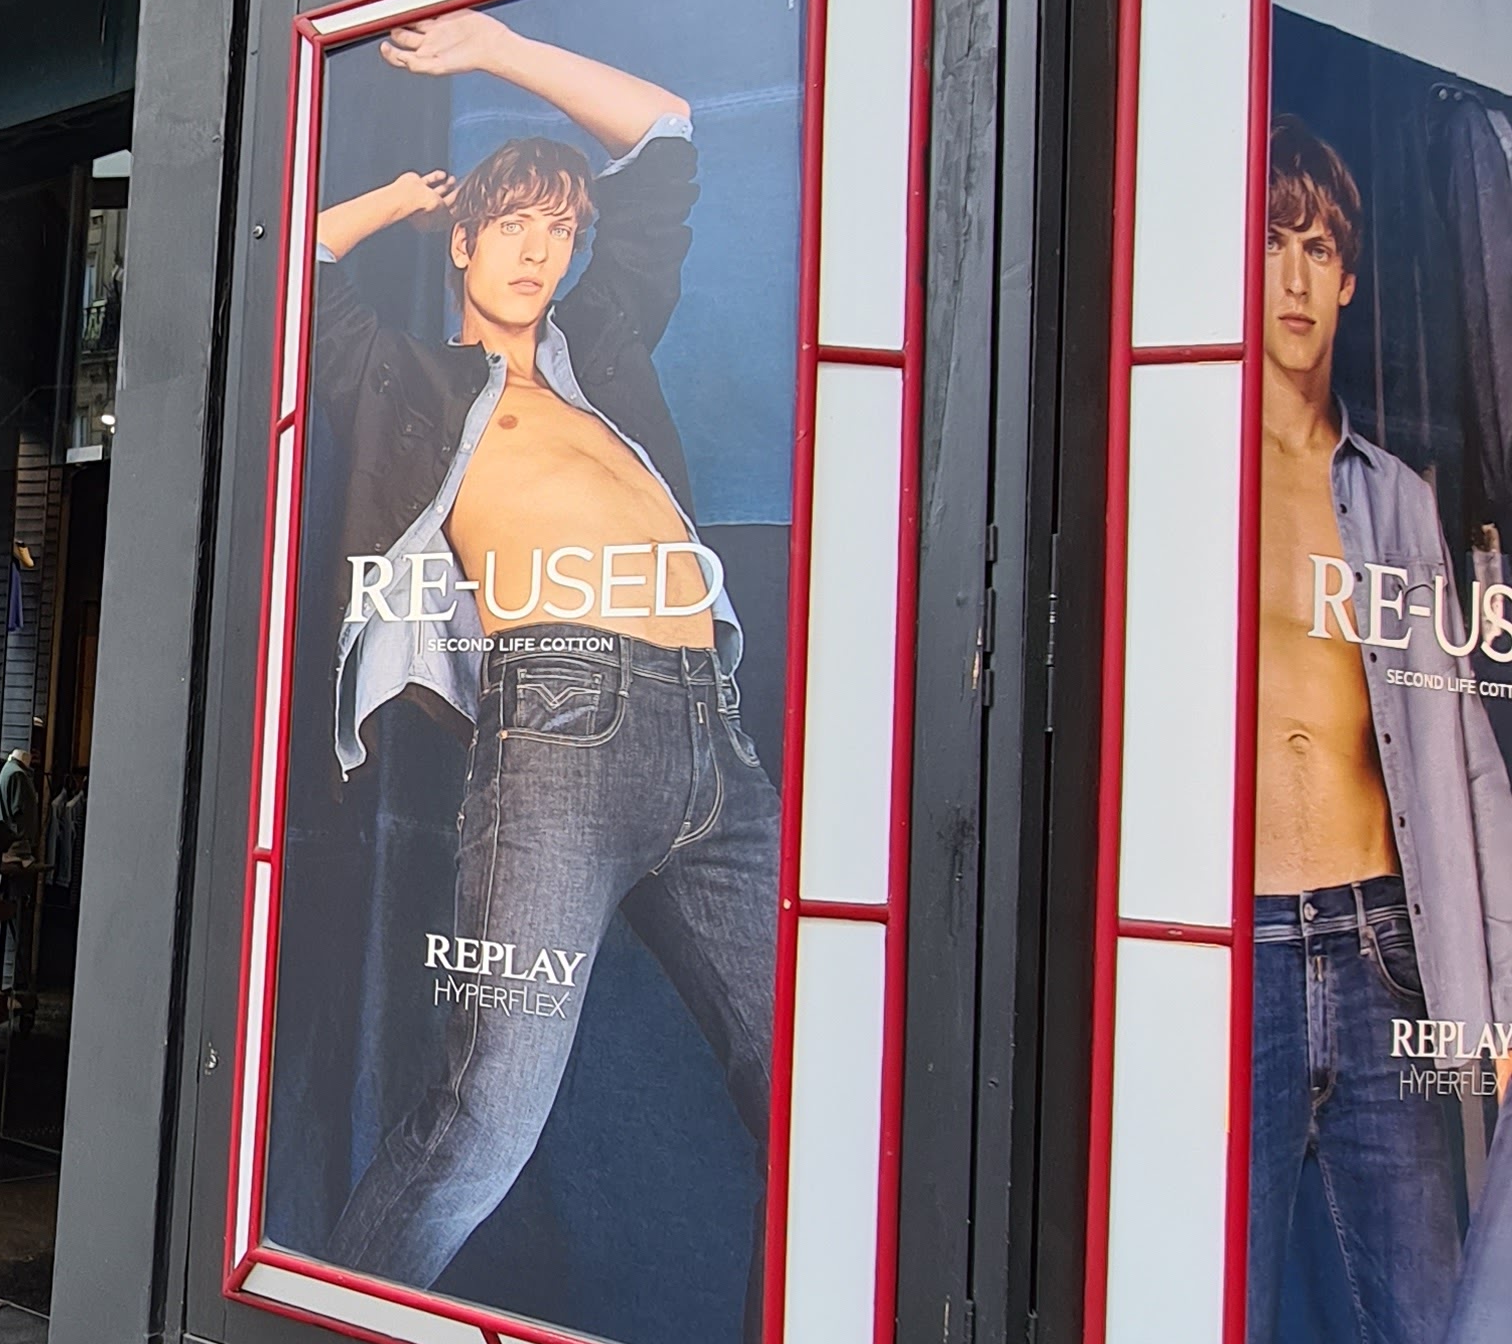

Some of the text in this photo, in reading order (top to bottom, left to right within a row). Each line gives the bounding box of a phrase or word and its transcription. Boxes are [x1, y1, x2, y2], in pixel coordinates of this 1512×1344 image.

[343, 541, 726, 623] RE-USED
[1306, 553, 1512, 663] RE-US
[426, 636, 615, 653] SECOND LIFE COTTON
[1386, 668, 1444, 690] SECOND
[1447, 677, 1477, 695] LIFE
[424, 933, 587, 987] REPLAY
[434, 974, 570, 1020] HYPERFLEX
[1390, 1018, 1512, 1060] REPLAY
